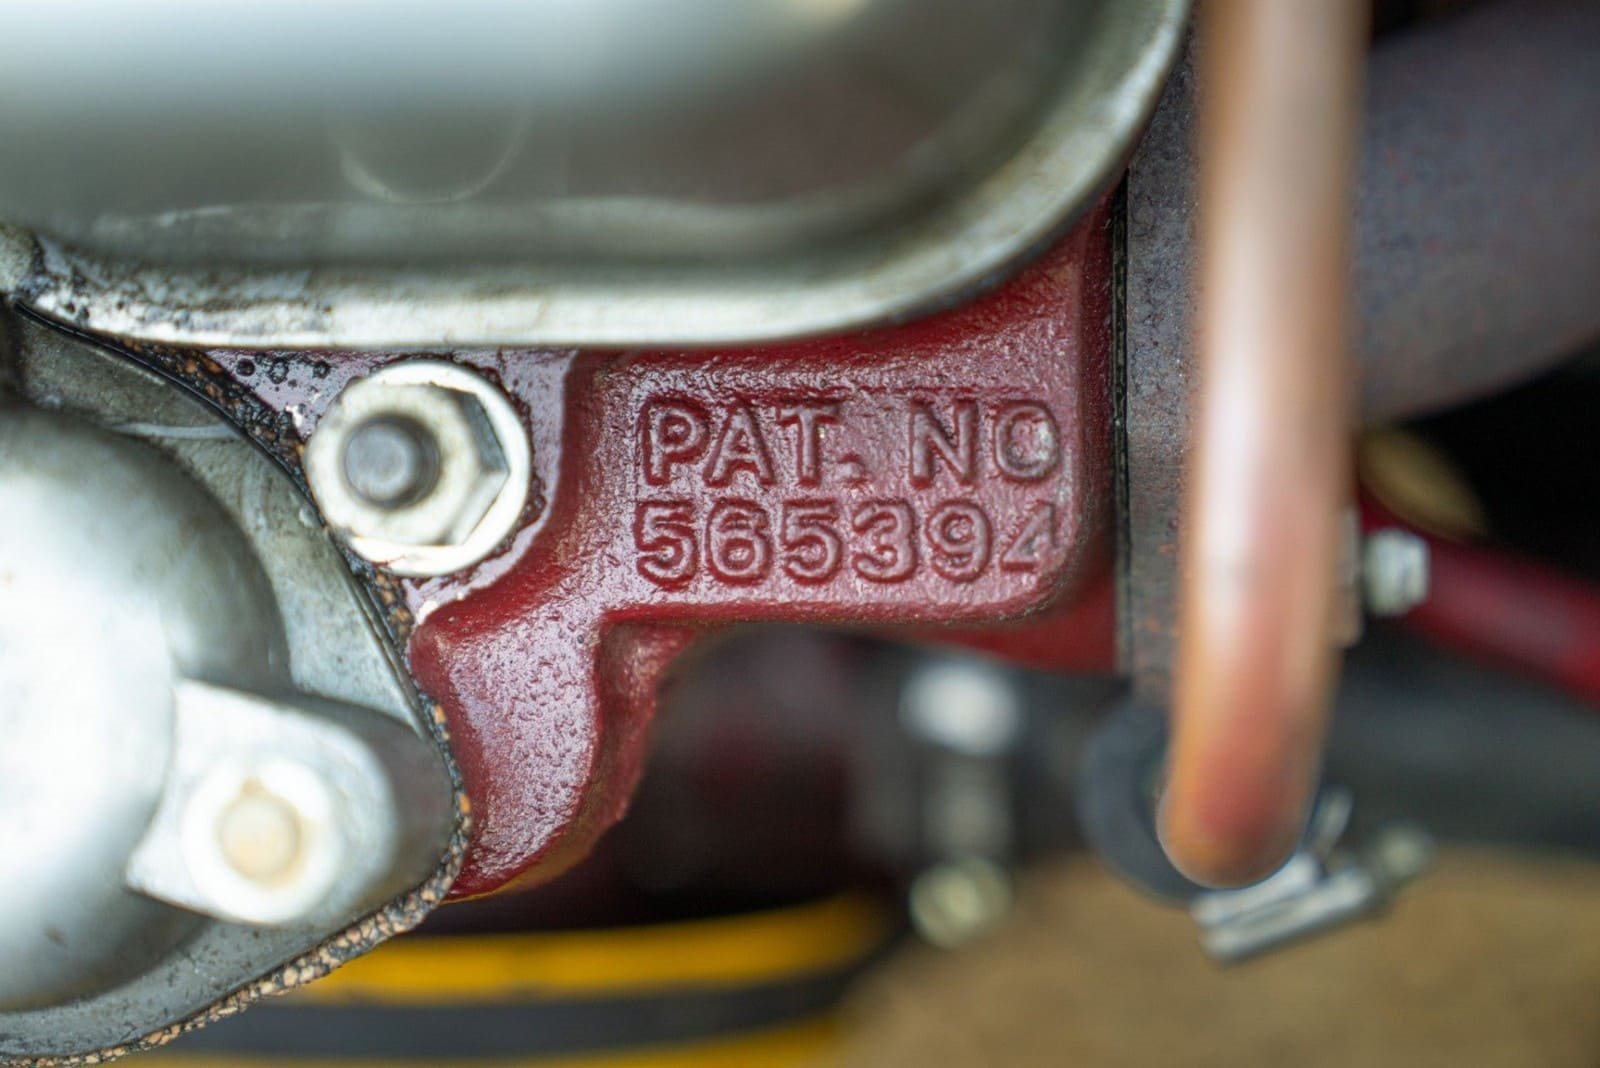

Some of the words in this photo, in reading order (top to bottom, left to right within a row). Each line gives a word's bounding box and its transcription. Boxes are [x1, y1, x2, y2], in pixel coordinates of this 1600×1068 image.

[640, 400, 866, 488] PAT.
[909, 399, 1060, 487] NO
[635, 499, 1057, 588] 565394
